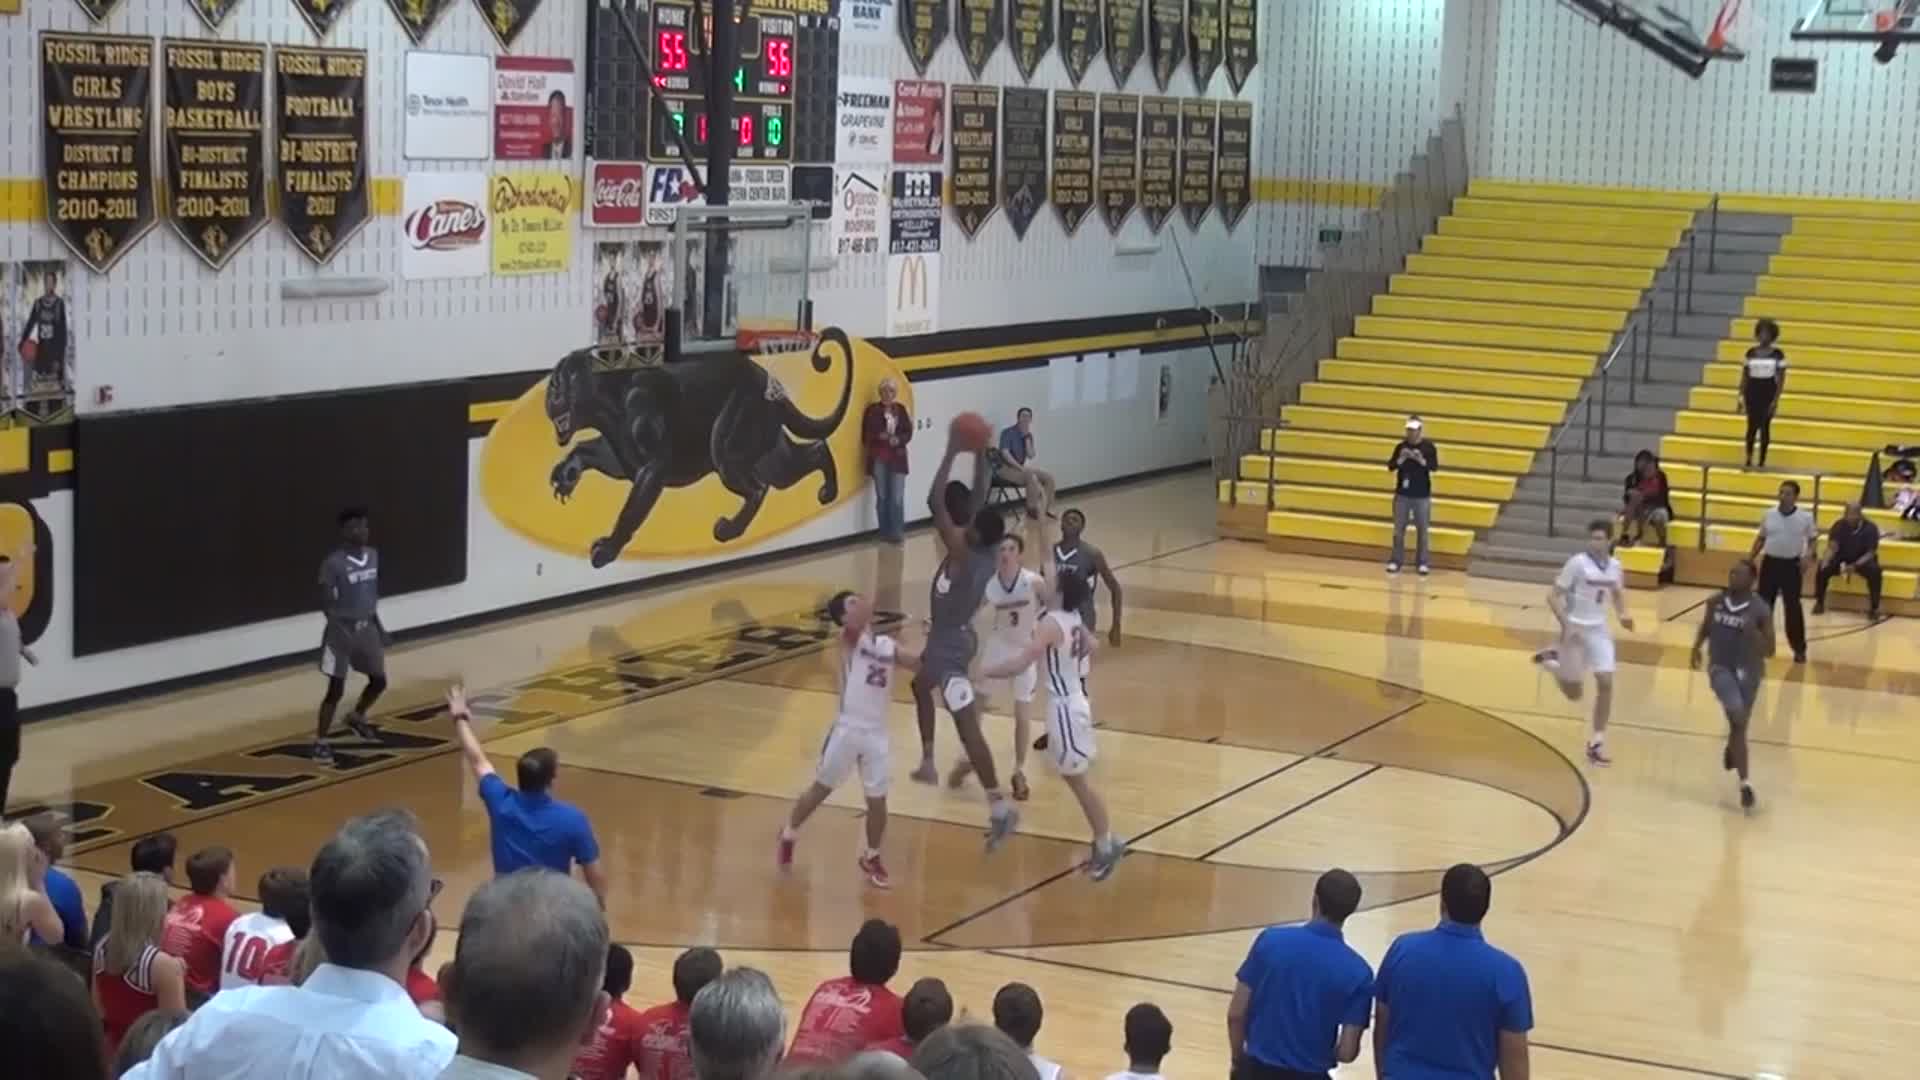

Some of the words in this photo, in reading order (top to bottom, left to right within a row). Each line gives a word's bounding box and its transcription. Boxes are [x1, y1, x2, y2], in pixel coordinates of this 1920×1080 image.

[658, 8, 685, 26] HOME
[762, 18, 793, 35] VISITOR
[46, 43, 99, 65] FOSSIL
[105, 45, 149, 67] RIDGE
[168, 50, 217, 70] FOSSIL
[221, 51, 262, 72] RIDGE
[661, 32, 687, 69] 55
[768, 41, 791, 75] 56
[278, 55, 322, 74] FOSSIL
[326, 57, 363, 77] RIDGE
[72, 77, 122, 98] GIRLS
[197, 80, 235, 101] BOYS
[285, 97, 354, 118] FOOTBALL
[839, 92, 890, 109] FREEMAN
[49, 106, 143, 129] WRESTLING
[167, 108, 260, 130] BASKETBALL
[63, 145, 118, 163] DISTRICT
[181, 146, 248, 164] BI-DISTRICT
[281, 141, 357, 162] BI-DISTRICT
[57, 171, 138, 190] CHAMPIONS
[180, 171, 248, 190] FINALISTS
[286, 172, 353, 191] FINALISTS
[57, 198, 138, 219] 2010-2011
[177, 197, 249, 217] 2010-2011
[306, 197, 336, 216] 2011
[648, 207, 675, 221] FIRST
[865, 663, 888, 688] 25
[225, 930, 268, 980] 10
